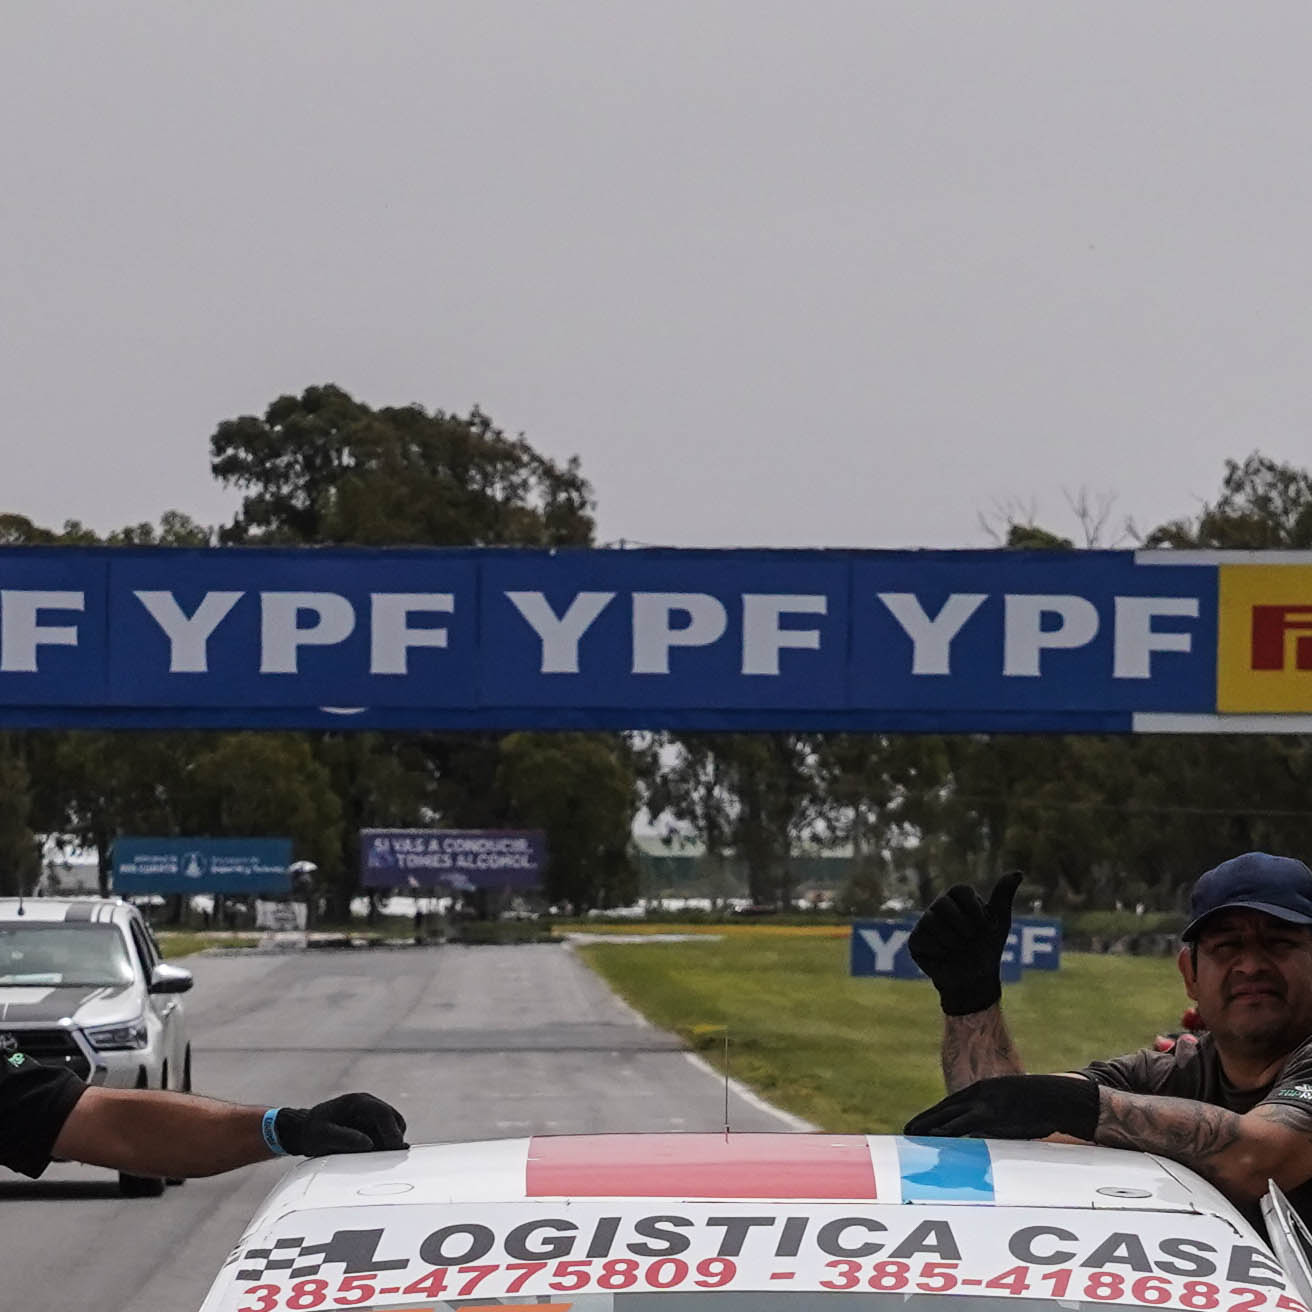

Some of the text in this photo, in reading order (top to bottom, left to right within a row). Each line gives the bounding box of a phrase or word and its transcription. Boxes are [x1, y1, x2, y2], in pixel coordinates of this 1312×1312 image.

[133, 590, 455, 675] YPF
[504, 591, 827, 675] YPF
[877, 592, 1199, 678] YPF
[324, 1215, 1287, 1290] LOGISTICA CASE
